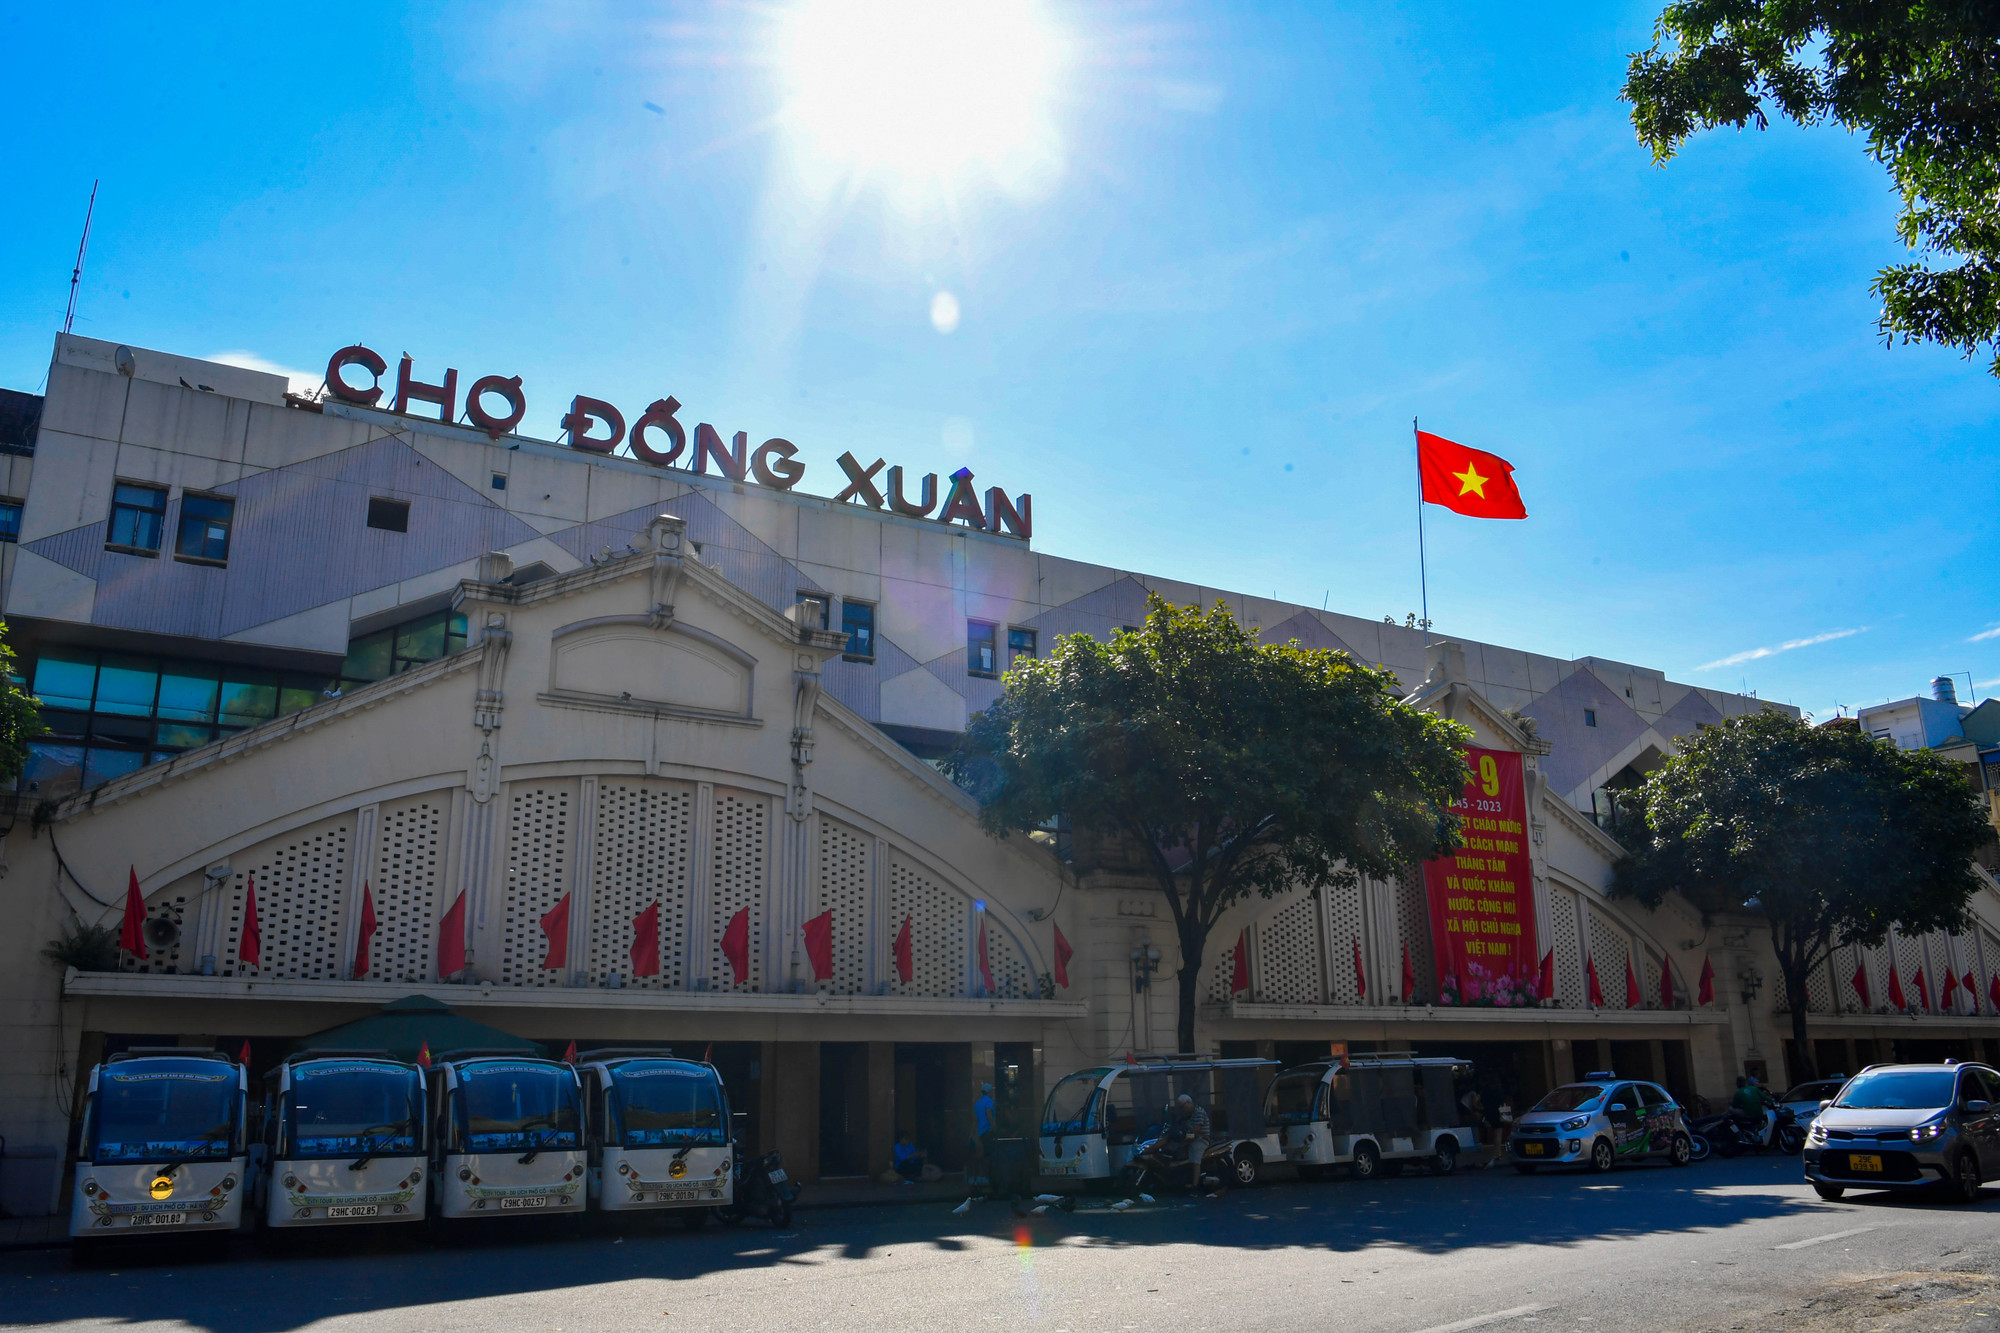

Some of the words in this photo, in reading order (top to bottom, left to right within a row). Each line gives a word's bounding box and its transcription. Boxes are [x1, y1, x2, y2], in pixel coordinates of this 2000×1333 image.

[325, 345, 527, 440] CHỢ
[832, 450, 1033, 539] XUÂN
[1476, 799, 1502, 813] 2023
[1472, 816, 1497, 832] CHÀO
[1498, 818, 1522, 835] MỪNG
[1470, 835, 1494, 851] CÁCH
[1495, 839, 1519, 855] MẠNG
[1455, 854, 1485, 871] THÁNG
[1486, 856, 1507, 873] TÁM
[1446, 874, 1460, 890] VÀ
[1462, 874, 1487, 891] QUỐC
[1487, 878, 1516, 894] KHÁNH
[1448, 895, 1476, 912] NƯỚC
[1477, 897, 1502, 915] CỘNG
[1446, 916, 1460, 932] XÃ
[1462, 917, 1480, 935] HỘI
[1480, 917, 1499, 934] CHỦ
[1465, 938, 1486, 957] VIỆT
[1487, 941, 1507, 956] NAM
[330, 1205, 376, 1217] 29HC-002.85
[503, 1197, 544, 1208] 29HC-002.57
